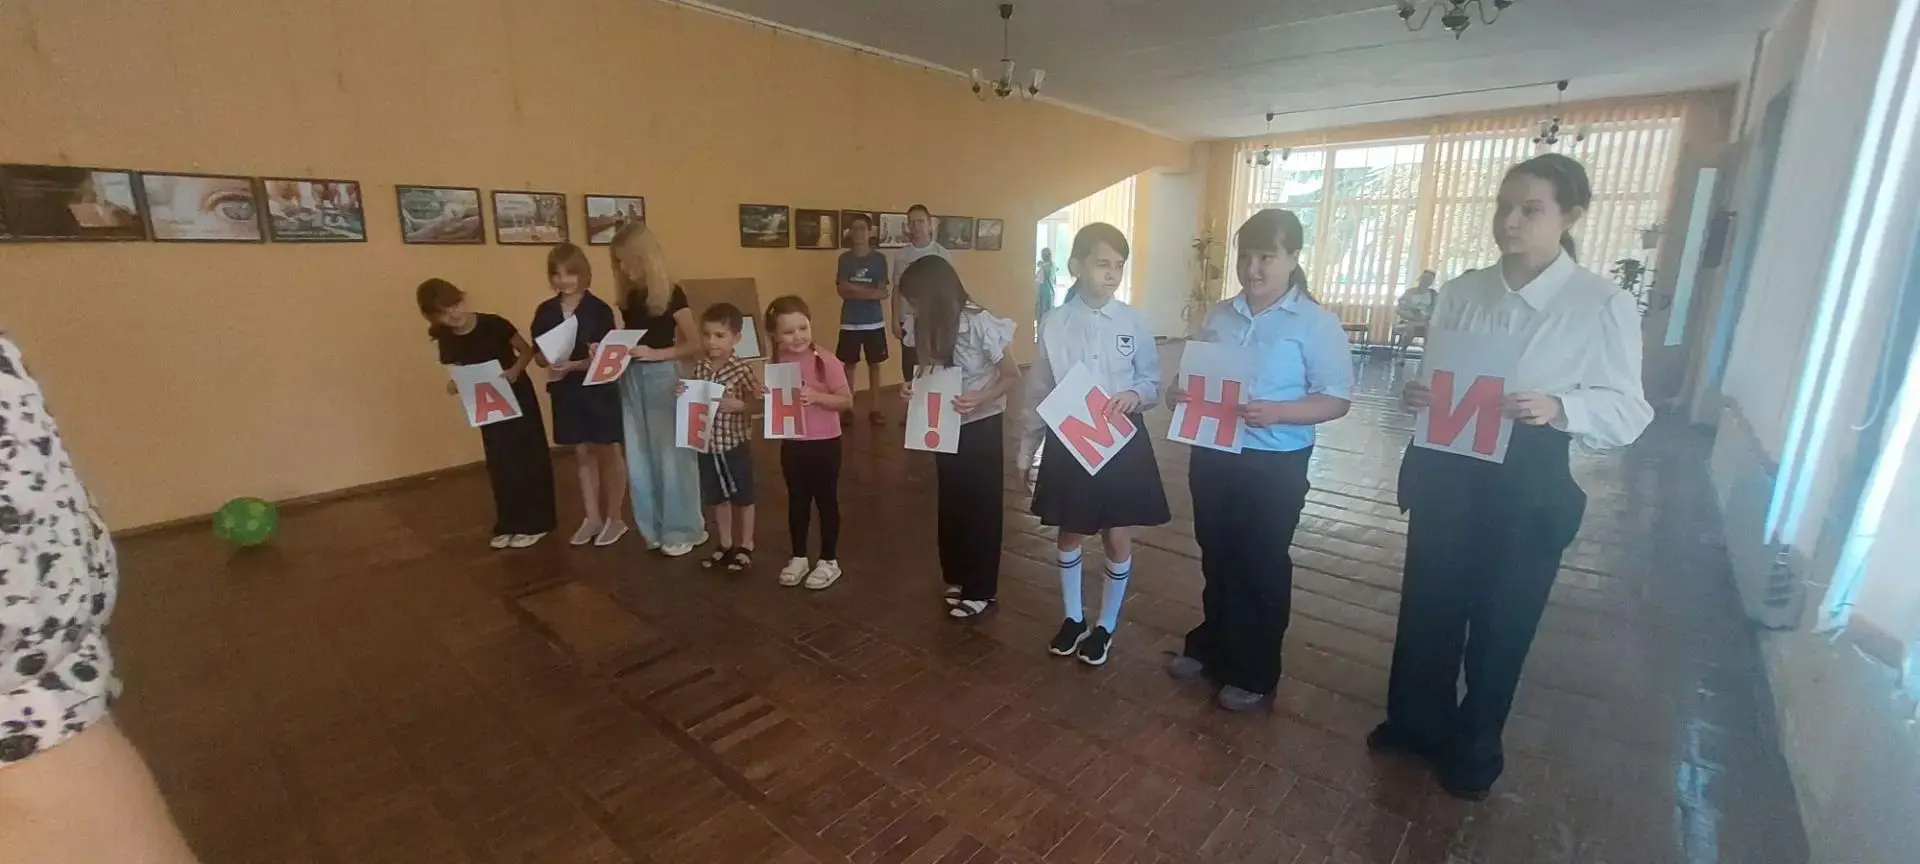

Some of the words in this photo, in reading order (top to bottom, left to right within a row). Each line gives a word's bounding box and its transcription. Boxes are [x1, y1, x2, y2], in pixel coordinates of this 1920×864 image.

[591, 343, 628, 383] В
[475, 382, 518, 423] А
[687, 402, 709, 450] Е
[772, 387, 804, 436] Н
[924, 392, 941, 449] !
[1058, 385, 1133, 468] М
[1179, 374, 1241, 447] Н
[1426, 368, 1505, 455] И
